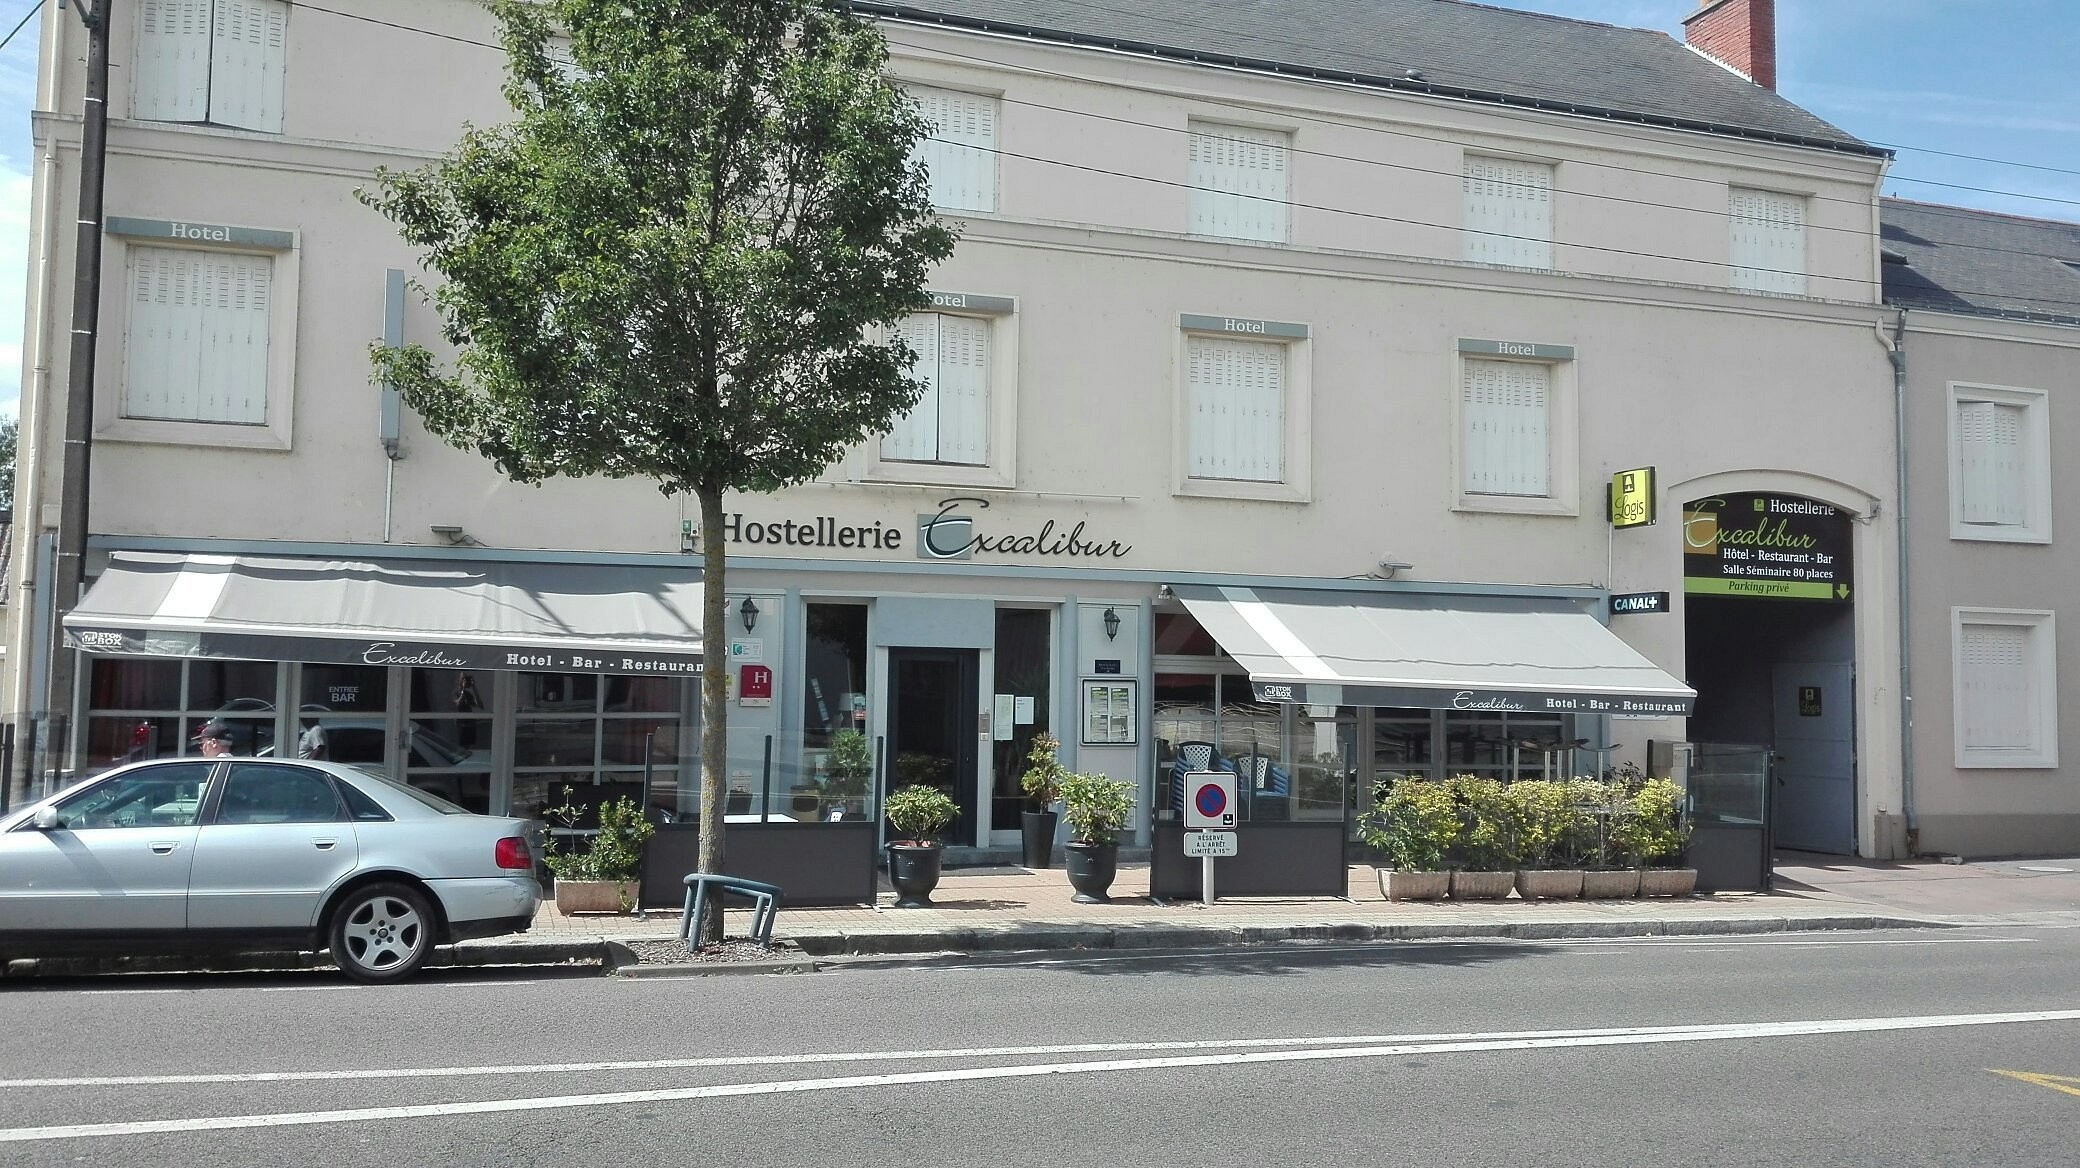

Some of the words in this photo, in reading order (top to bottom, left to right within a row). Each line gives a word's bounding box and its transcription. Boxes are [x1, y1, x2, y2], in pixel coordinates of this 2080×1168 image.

[171, 223, 231, 241] Hotel
[932, 295, 967, 308] otel
[1224, 319, 1265, 333] Hotel
[1498, 342, 1536, 356] Hotel
[1614, 495, 1645, 521] Logis
[1770, 499, 1835, 516] Hostellerie
[722, 513, 902, 550] Hostellerie
[921, 497, 1133, 559] Excalibur
[1684, 499, 1817, 549] Excalibur
[1723, 548, 1749, 560] Hôtel
[1758, 550, 1809, 563] Restaurant
[1817, 553, 1833, 564] Bar
[1723, 564, 1745, 575] Salle
[1747, 565, 1791, 577] Séminaire
[1793, 568, 1805, 577] 80
[1806, 568, 1834, 580] places
[1728, 581, 1764, 594] Parking
[1765, 583, 1790, 594] privé
[1614, 596, 1658, 611] CANAL+
[97, 632, 123, 640] STOK
[97, 638, 122, 646] BOX
[362, 642, 467, 666] Excalibur
[507, 653, 552, 666] Hotel
[572, 656, 602, 669] Bar
[622, 658, 704, 672] Restauran
[754, 671, 768, 684] H
[331, 693, 355, 702] BAR
[1452, 690, 1524, 710] Excalibur
[1546, 698, 1577, 709] Hotel
[1590, 700, 1610, 710] Bar
[1623, 700, 1686, 712] Restaurant
